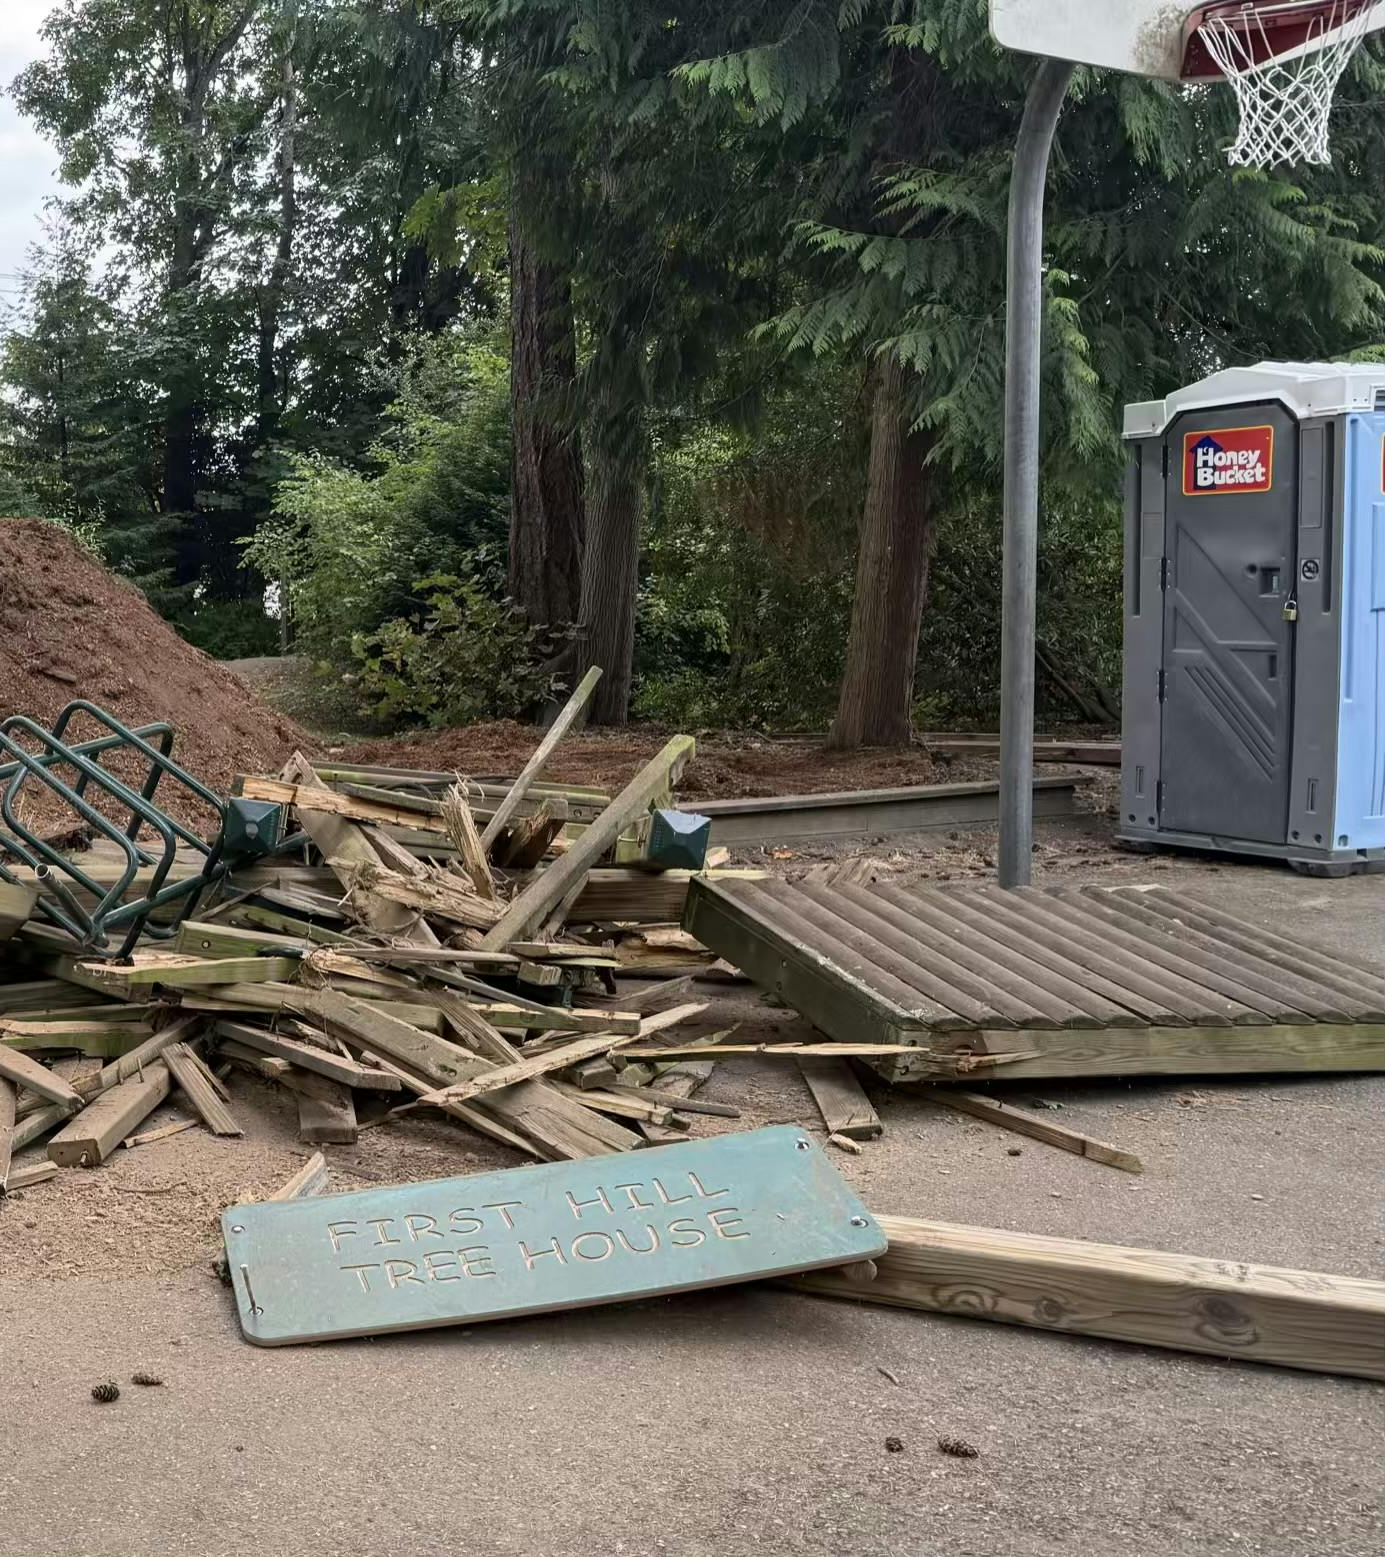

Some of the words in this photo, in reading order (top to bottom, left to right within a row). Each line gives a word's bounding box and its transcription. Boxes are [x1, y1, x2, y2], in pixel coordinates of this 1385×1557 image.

[1197, 447, 1261, 469] Honey
[1197, 462, 1266, 487] Bucket
[327, 1201, 522, 1252] FIRST
[565, 1171, 730, 1220] HILL
[339, 1246, 497, 1294] TREE
[518, 1207, 751, 1273] HOUSE
